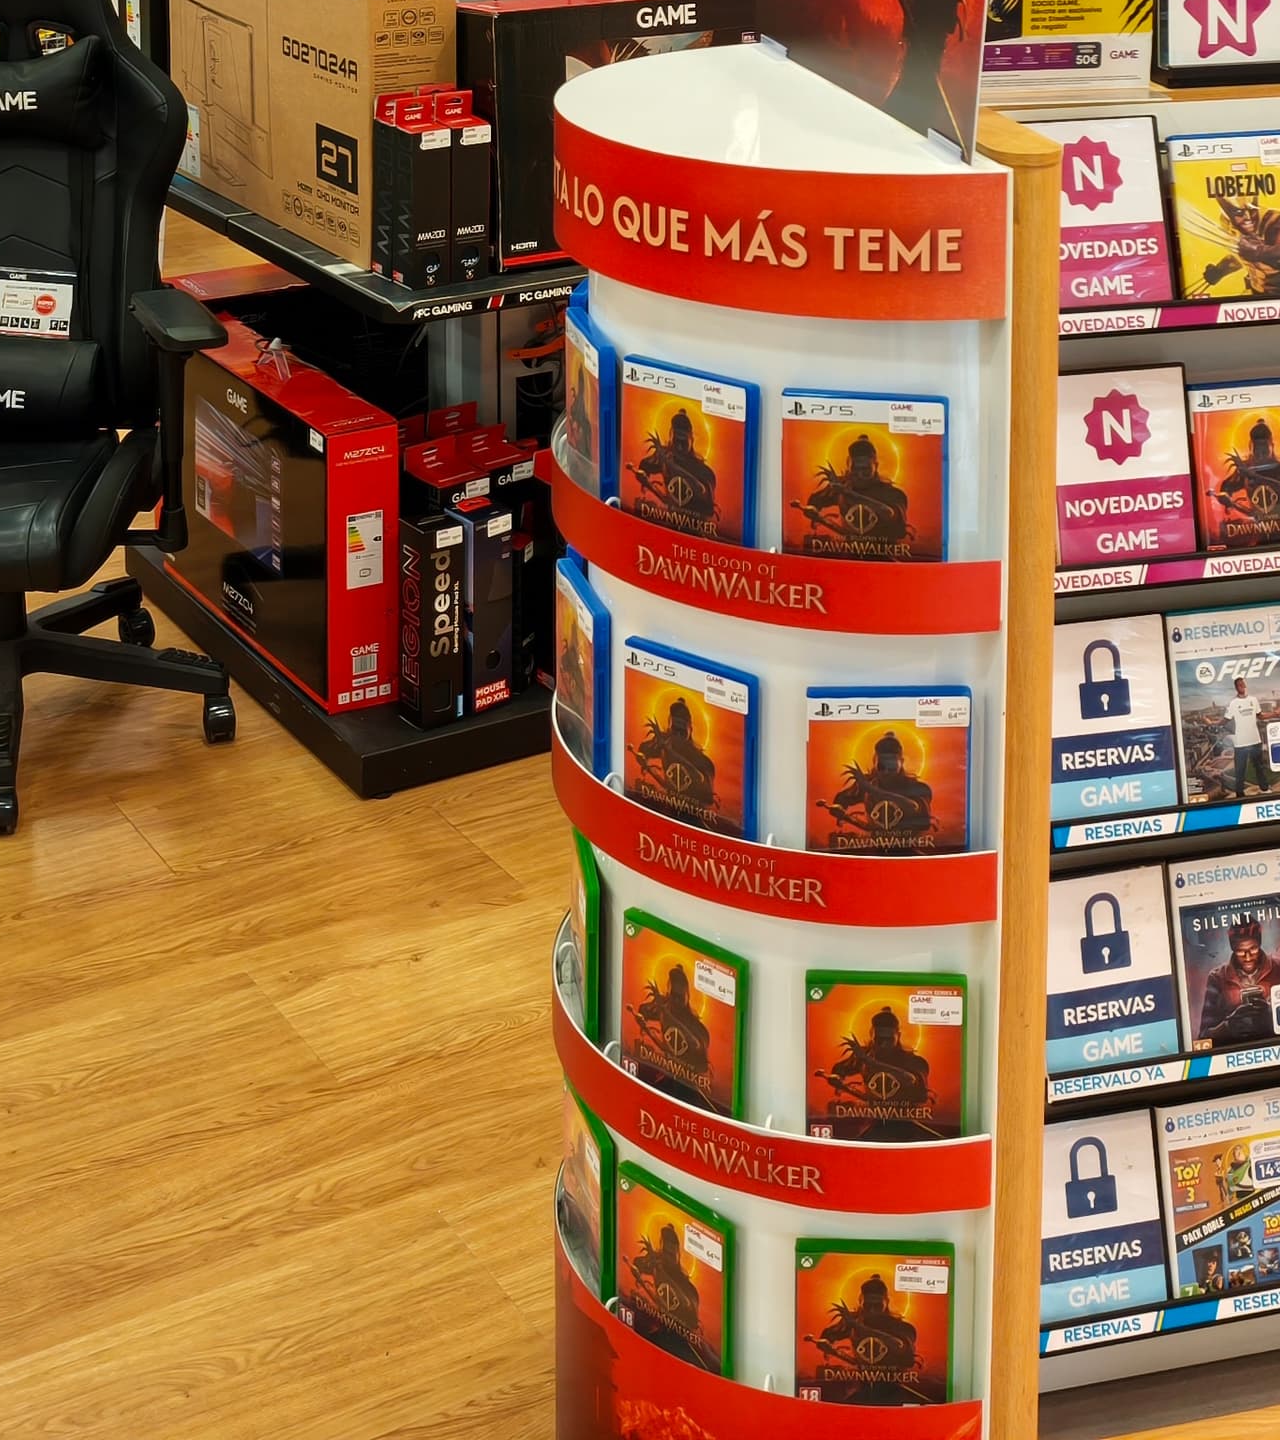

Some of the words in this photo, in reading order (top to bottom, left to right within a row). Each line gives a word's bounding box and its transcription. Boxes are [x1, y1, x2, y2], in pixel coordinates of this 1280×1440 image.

[636, 3, 697, 28] GAME
[1109, 49, 1140, 60] GAME
[320, 138, 354, 181] 27
[1206, 172, 1276, 199] LOBEZNO
[456, 223, 485, 238] MM200
[573, 177, 605, 229] LO
[612, 195, 689, 254] QUE
[704, 209, 809, 270] MÁS
[824, 226, 962, 273] TEME
[519, 291, 531, 303] PC
[532, 285, 573, 301] GAMING
[671, 543, 699, 561] THE
[701, 549, 754, 571] BLOOD
[756, 561, 777, 578] OF
[637, 544, 828, 614] DAWNWALKER
[429, 549, 452, 658] Speed
[400, 544, 421, 712] LEGION
[1184, 619, 1266, 641] RESÉRVALO
[1216, 655, 1280, 681] FC27
[474, 694, 492, 710] PAD
[492, 688, 510, 704] XXL
[475, 680, 506, 697] MOUSE
[1060, 744, 1156, 771] RESERVAS
[1080, 782, 1143, 809] GAME
[1186, 861, 1269, 887] RESÉRVALO
[1192, 909, 1252, 933] SILENT
